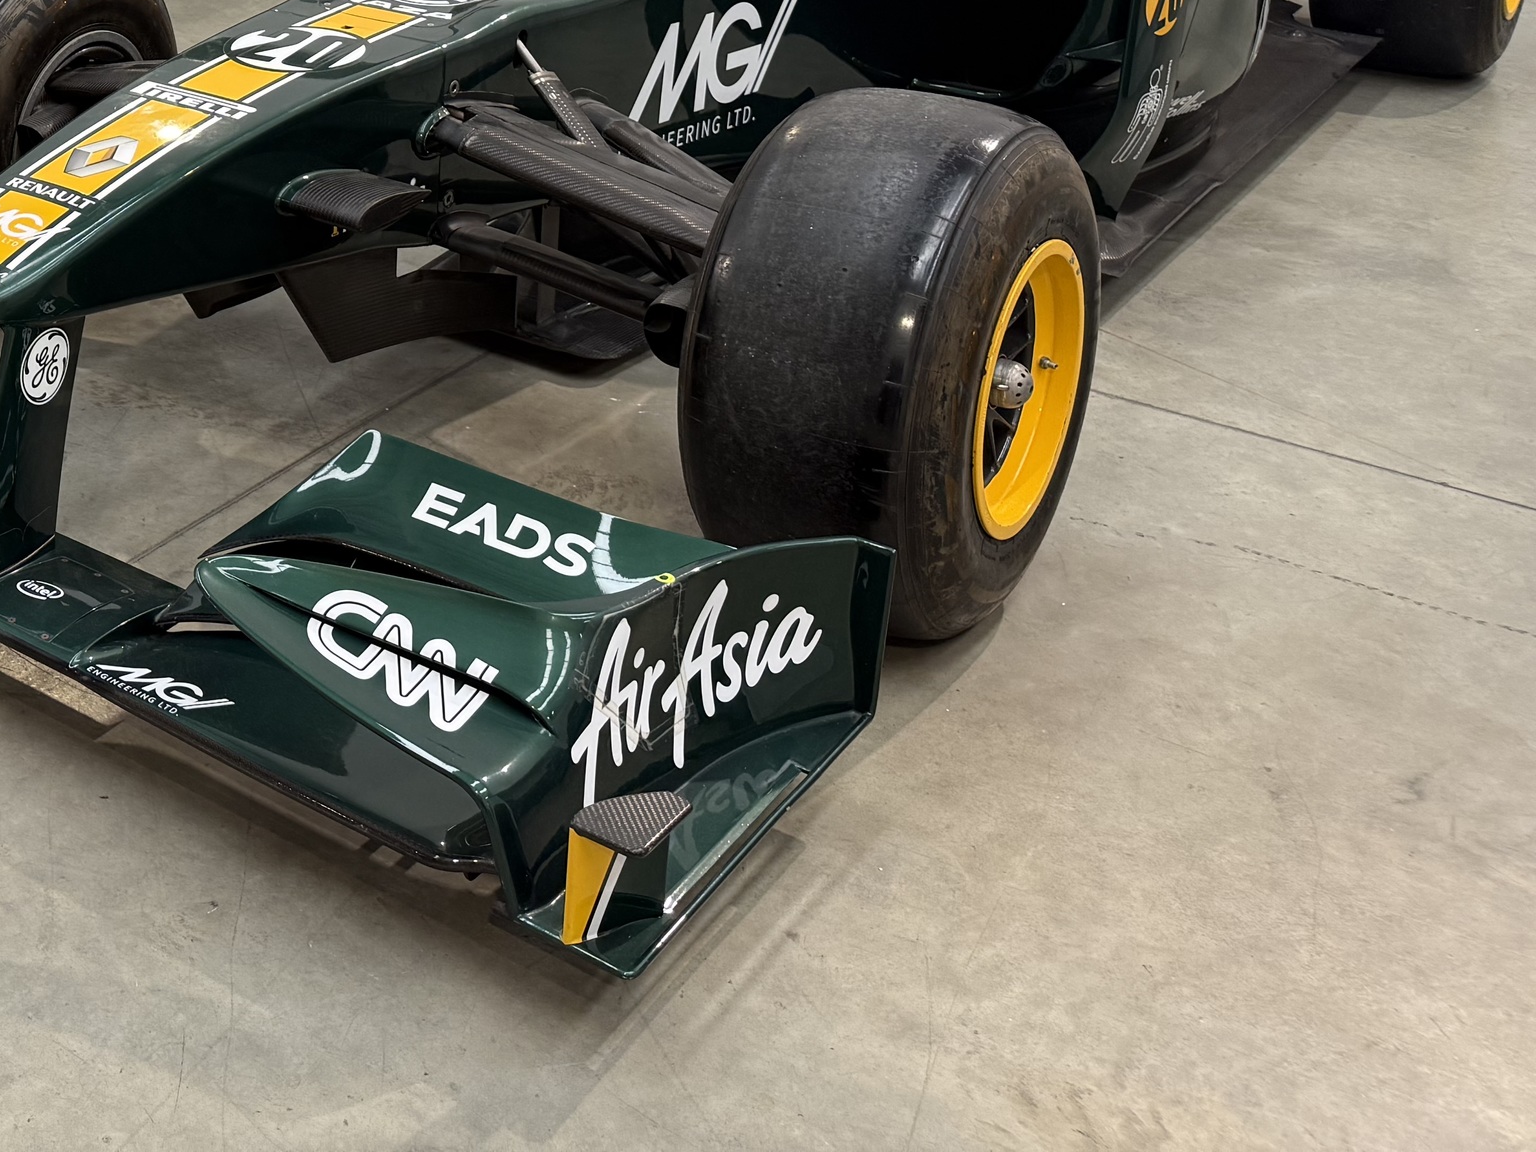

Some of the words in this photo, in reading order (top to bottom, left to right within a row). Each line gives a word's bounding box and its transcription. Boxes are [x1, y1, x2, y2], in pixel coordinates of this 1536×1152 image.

[129, 80, 258, 120] PIRELLI
[662, 115, 722, 148] EERING
[726, 105, 757, 131] LTD.
[5, 177, 97, 211] RENAULT
[410, 481, 596, 579] EADS
[23, 580, 62, 600] intel
[305, 588, 500, 734] CNN
[86, 665, 156, 704] ENGINEERING
[157, 701, 179, 717] LTD.
